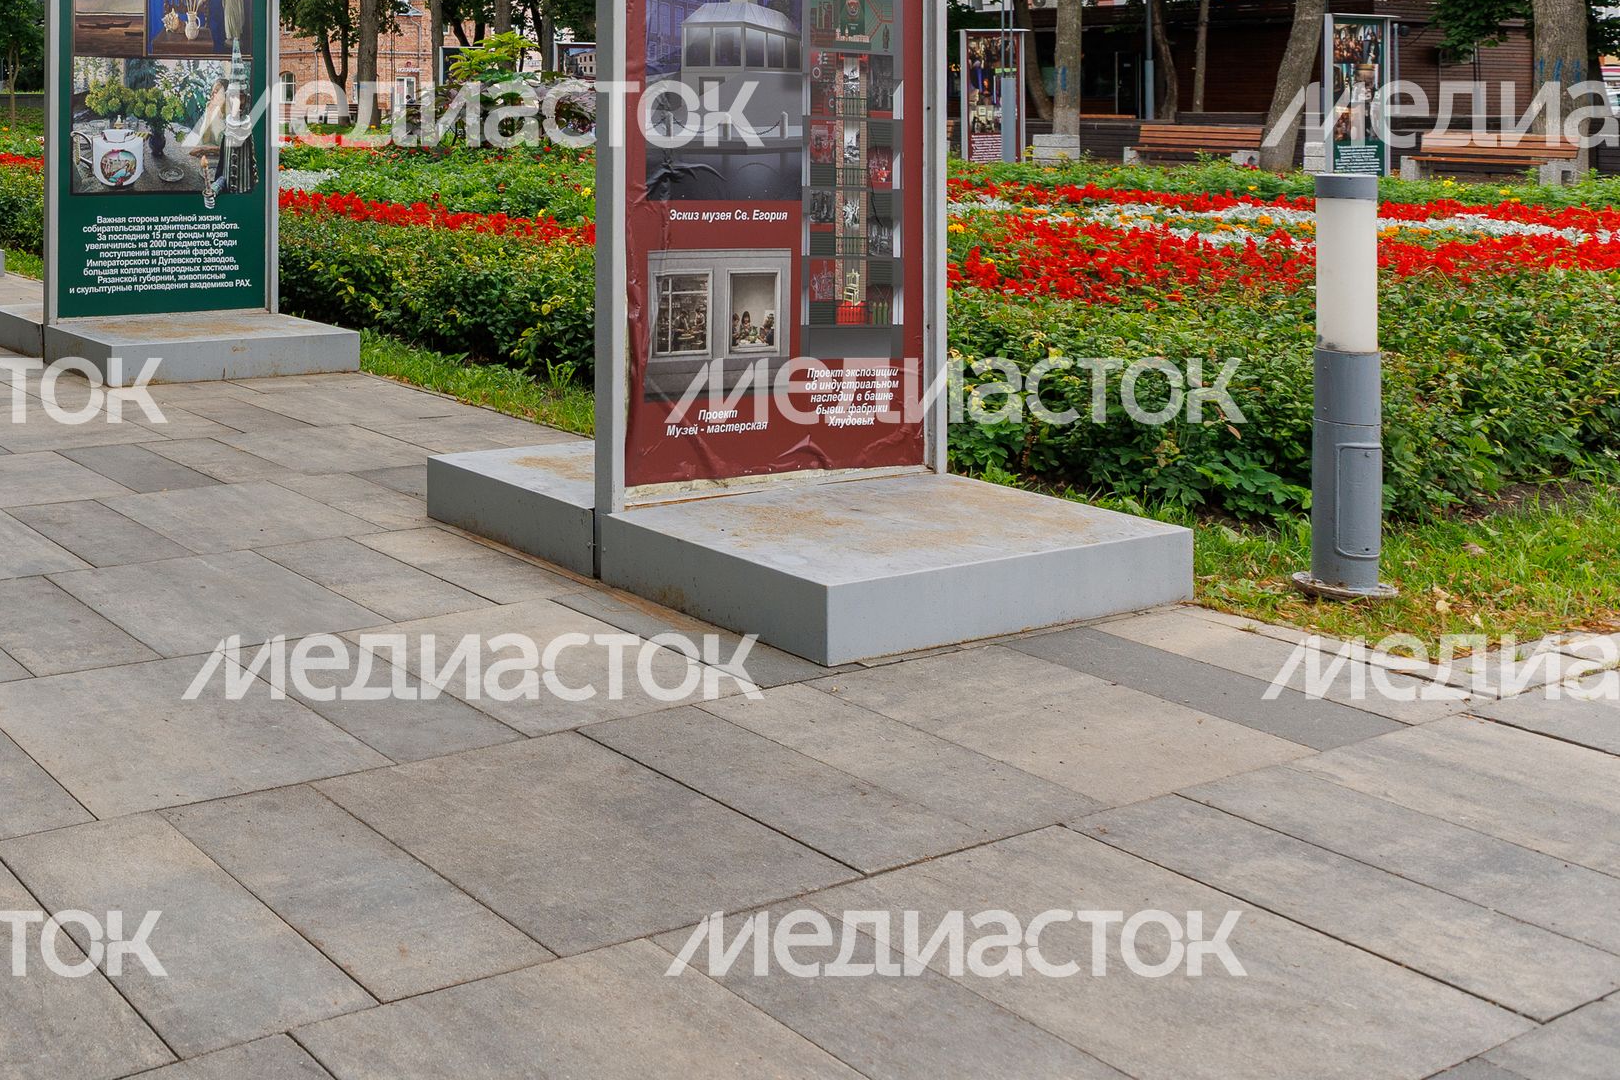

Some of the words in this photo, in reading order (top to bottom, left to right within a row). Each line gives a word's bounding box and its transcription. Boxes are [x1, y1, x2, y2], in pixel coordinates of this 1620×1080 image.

[161, 214, 196, 223] музейной
[670, 209, 699, 220] Эскиз
[702, 212, 731, 223] музея
[734, 209, 750, 220] Св.
[753, 210, 788, 222] Егория
[83, 224, 145, 233] собирательская
[154, 223, 210, 232] хранительская
[86, 242, 137, 251] увеличились
[169, 240, 211, 248] предметов.
[100, 249, 149, 258] поступлений
[151, 248, 190, 257] авторский
[87, 258, 149, 268] Императорского
[158, 257, 201, 266] Дулевского
[120, 266, 160, 275] коллекция
[162, 265, 200, 273] народных
[98, 276, 137, 284] Рязанской
[139, 274, 176, 283] губернии,
[178, 273, 225, 282] живописные
[77, 285, 132, 295] скульптурные
[134, 282, 188, 292] произведения
[190, 281, 233, 289] академиков
[807, 368, 844, 379] Проект
[846, 368, 898, 379] экспозиции
[806, 380, 817, 391] об
[819, 379, 899, 392] индустриальном
[811, 391, 854, 403] наследии
[857, 392, 862, 401] в
[864, 391, 893, 402] башне
[816, 403, 845, 415] бывш.
[848, 403, 888, 415] фабрики
[699, 409, 737, 422] Проект
[829, 416, 874, 427] Хлудовых
[667, 424, 698, 437] Музей
[707, 422, 767, 435] мастерская
